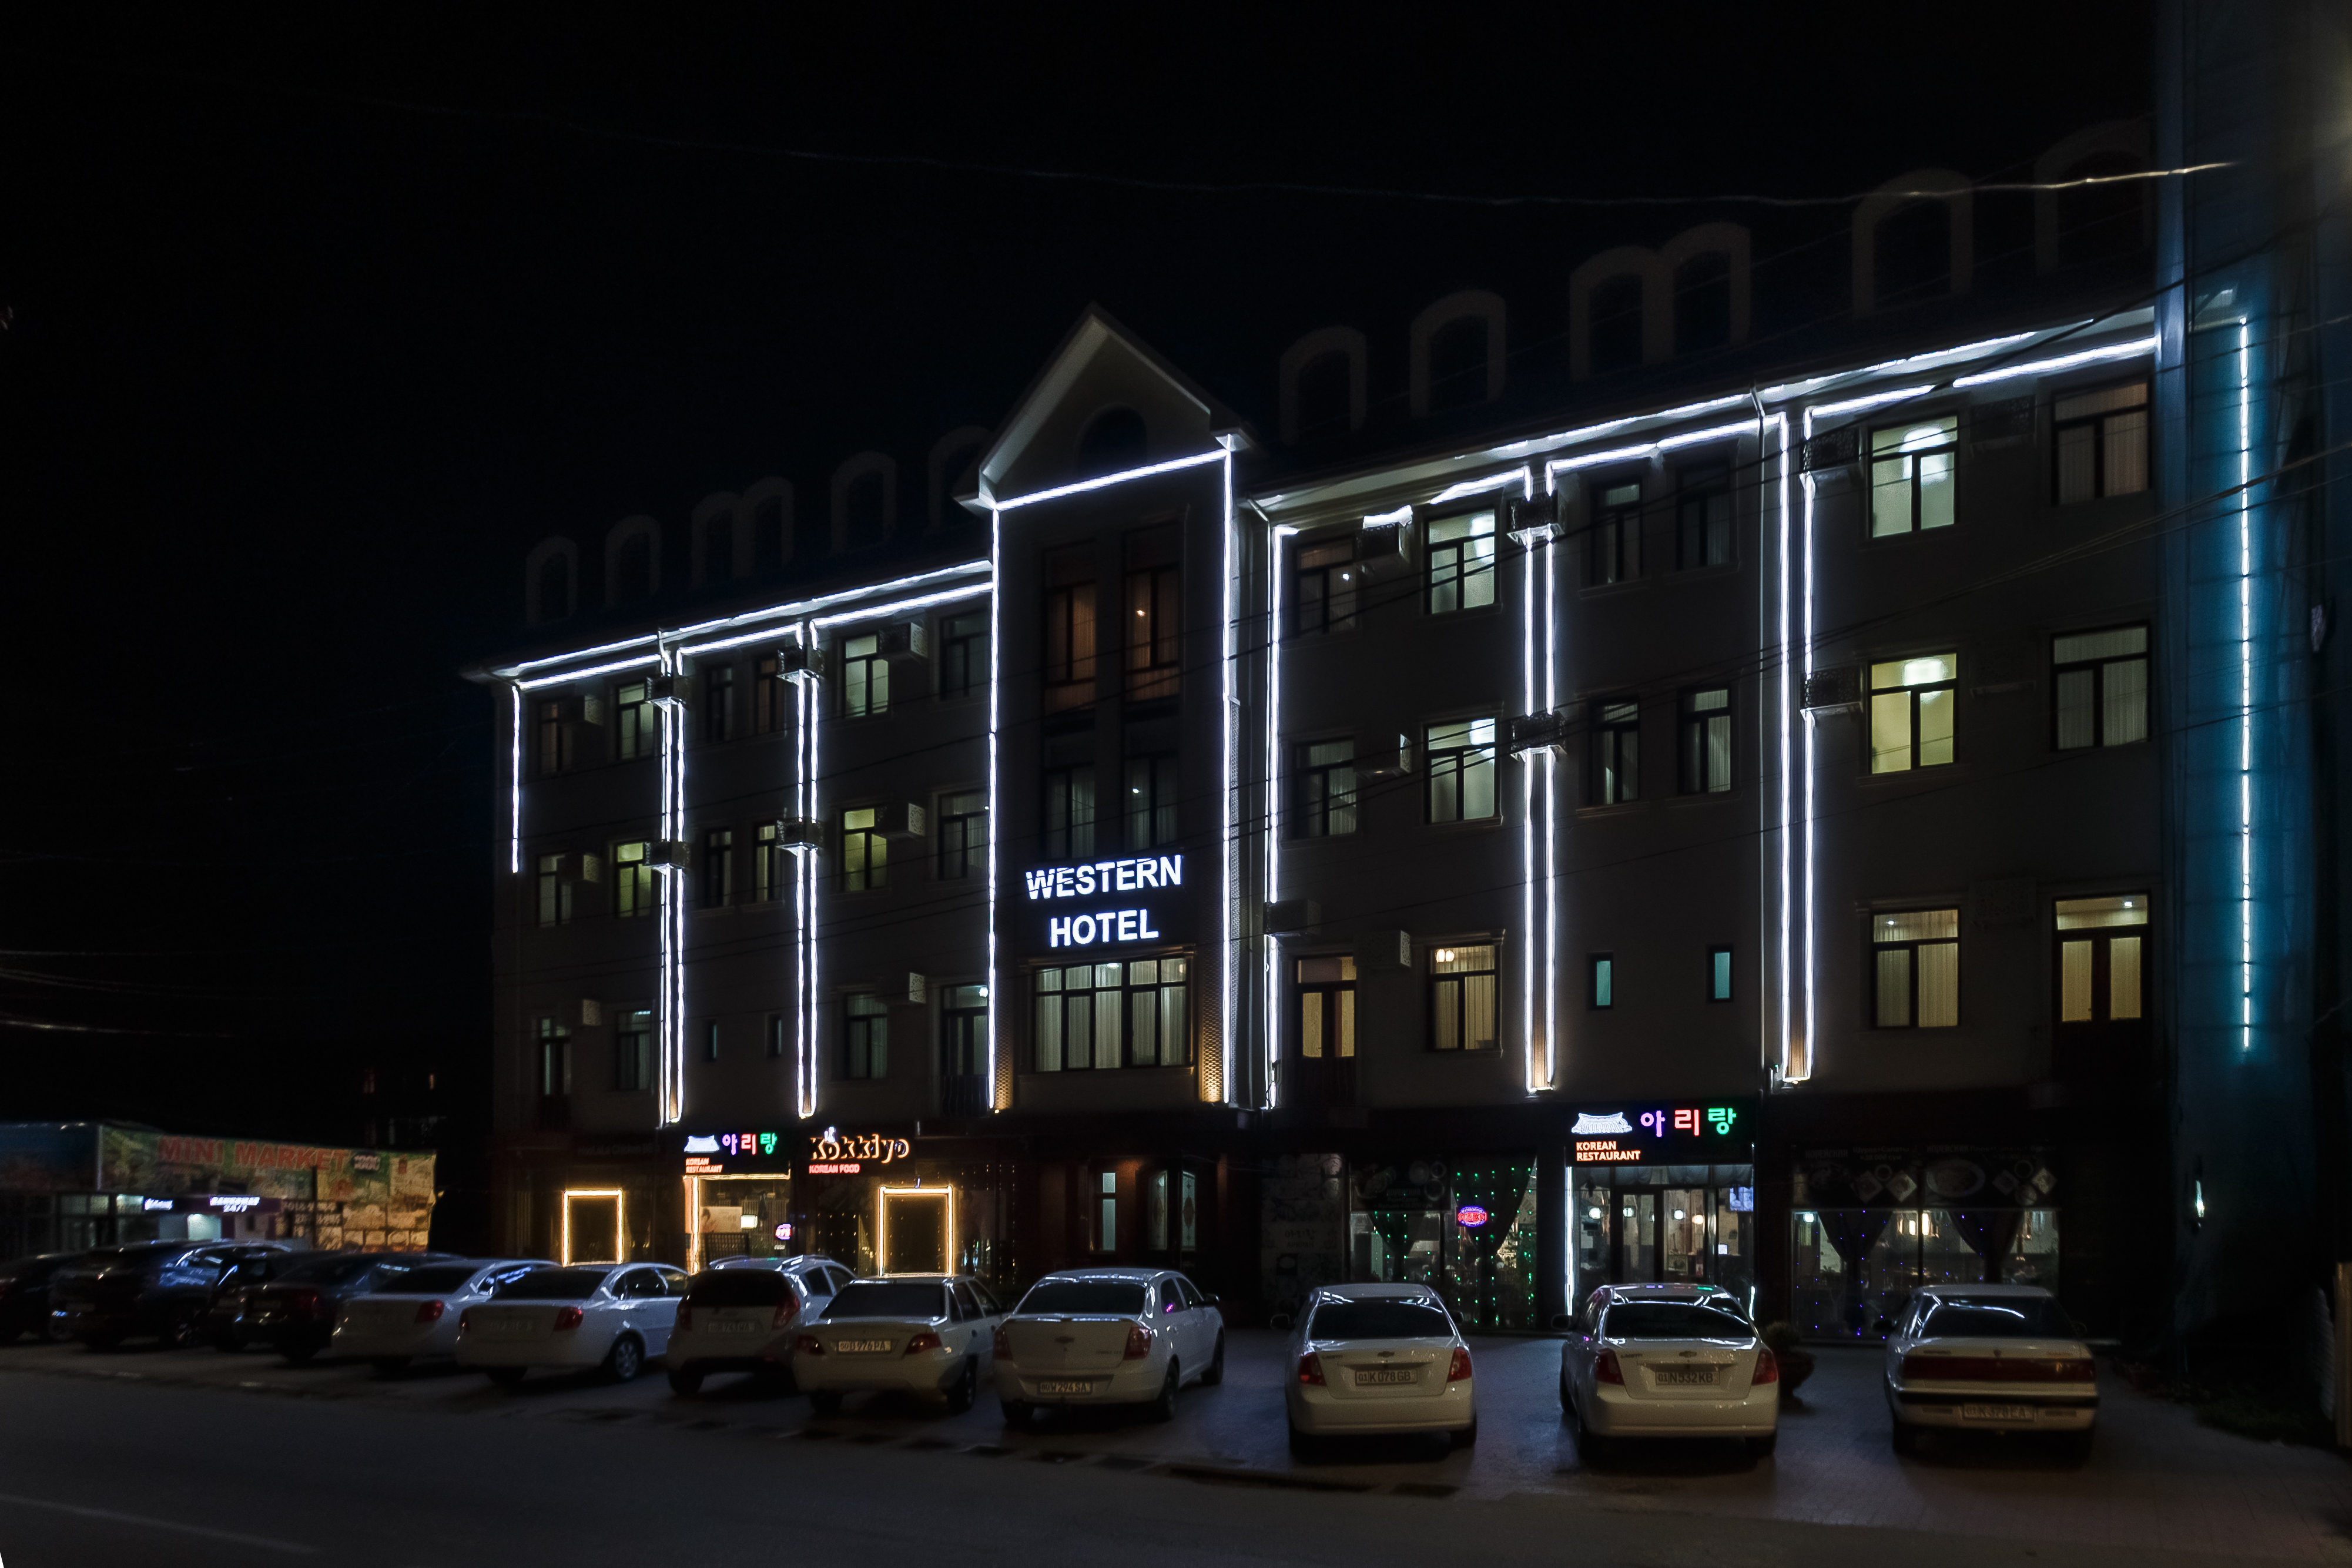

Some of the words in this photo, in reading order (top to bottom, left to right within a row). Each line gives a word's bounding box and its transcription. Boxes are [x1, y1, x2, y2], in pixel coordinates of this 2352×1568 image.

[1026, 855, 1182, 900] WESTERN
[1050, 909, 1159, 947] HOTEL
[1640, 1107, 1737, 1138] 아리랑
[722, 1133, 778, 1155] 아리랑
[1576, 1141, 1617, 1151] KOREAN
[158, 1135, 223, 1164] MINI
[235, 1140, 349, 1172] MARKET
[685, 1157, 709, 1165] KOREAN
[1576, 1150, 1641, 1161] RESTAURANT
[685, 1164, 723, 1174] RESTAURANT
[809, 1164, 839, 1174] KOREAN
[839, 1164, 860, 1174] FOOD
